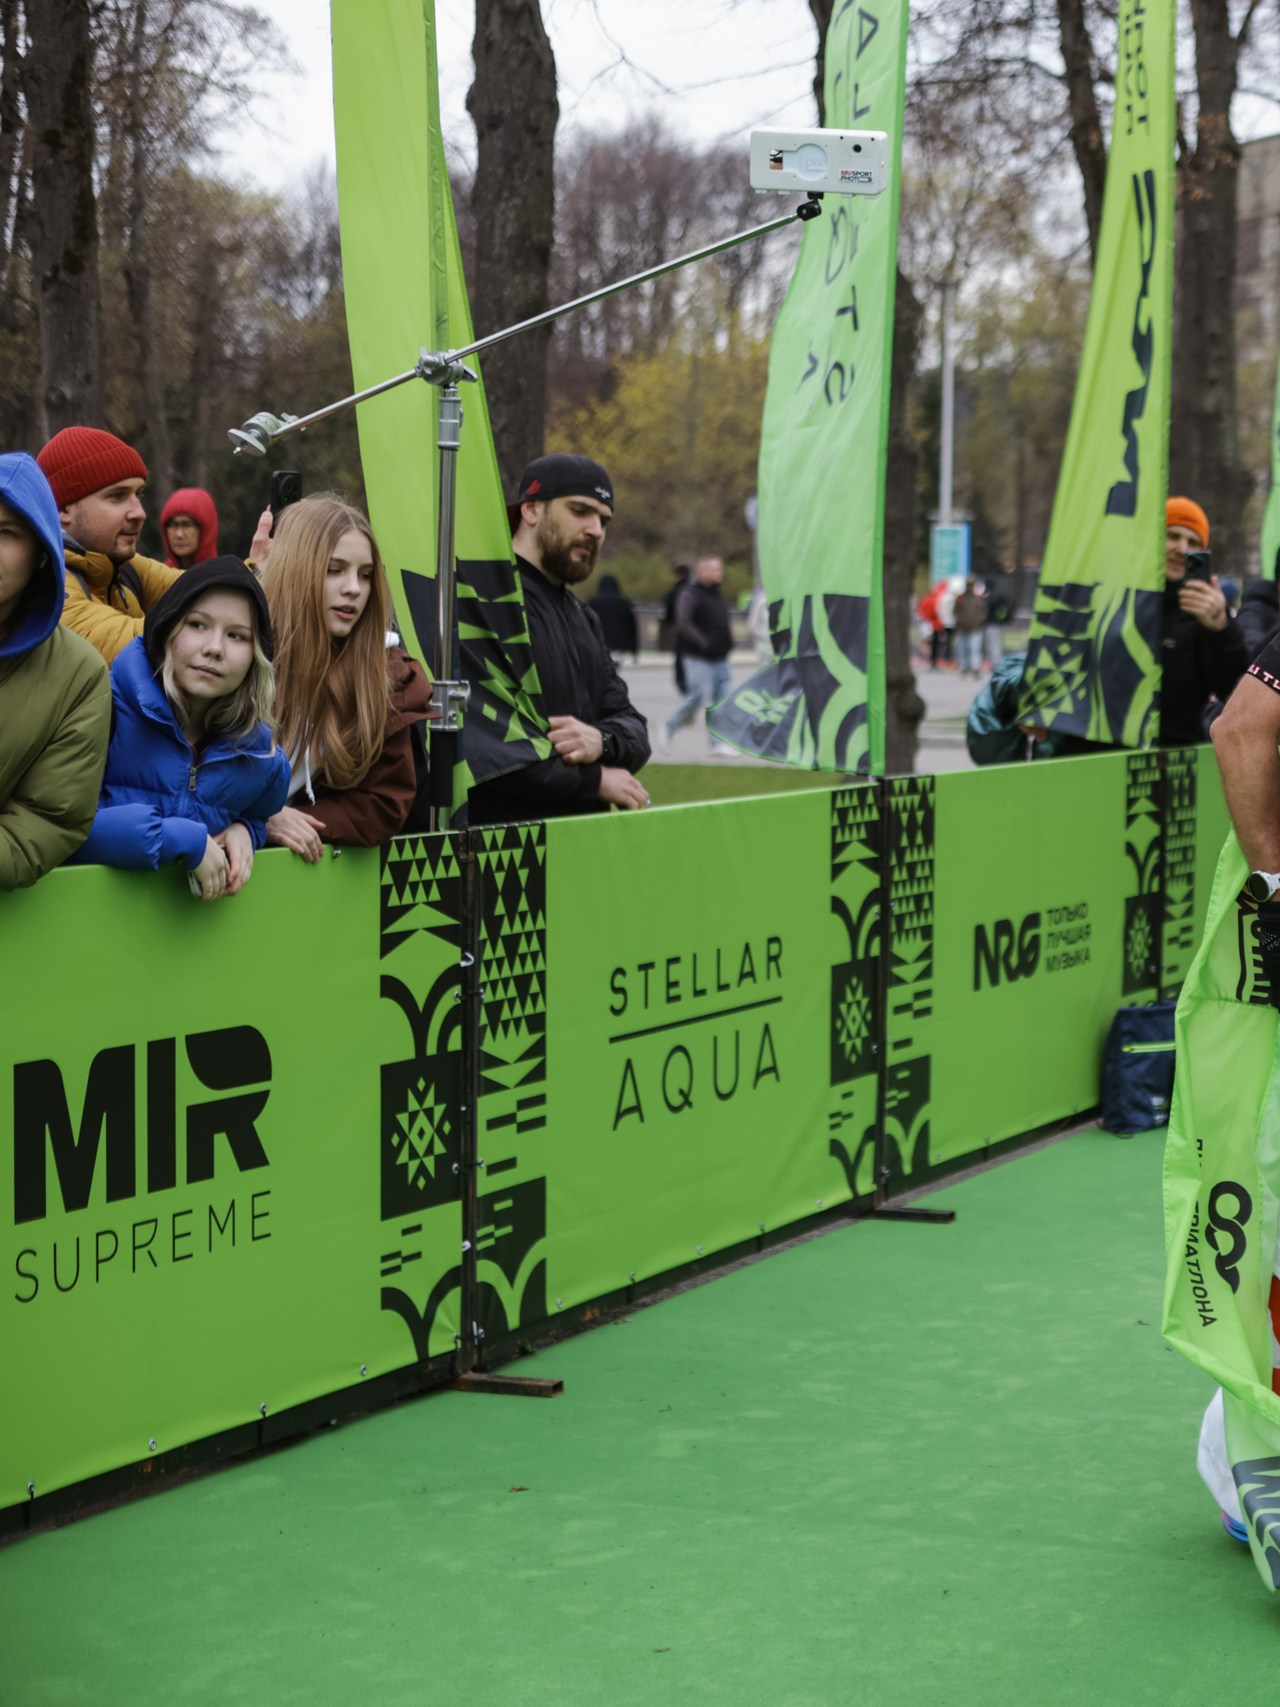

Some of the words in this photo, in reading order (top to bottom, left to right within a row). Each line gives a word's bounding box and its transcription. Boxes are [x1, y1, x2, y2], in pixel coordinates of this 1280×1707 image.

[974, 912, 1042, 992] NRG
[1046, 902, 1089, 927] ТОЛЬКО
[1046, 924, 1092, 950] ЛУЧШАЯ
[609, 935, 783, 1019] STELLAR
[1046, 947, 1091, 973] МУЗЫКА
[611, 1024, 781, 1133] AQUA
[13, 1024, 273, 1225] MIR
[14, 1189, 273, 1305] SUPREME
